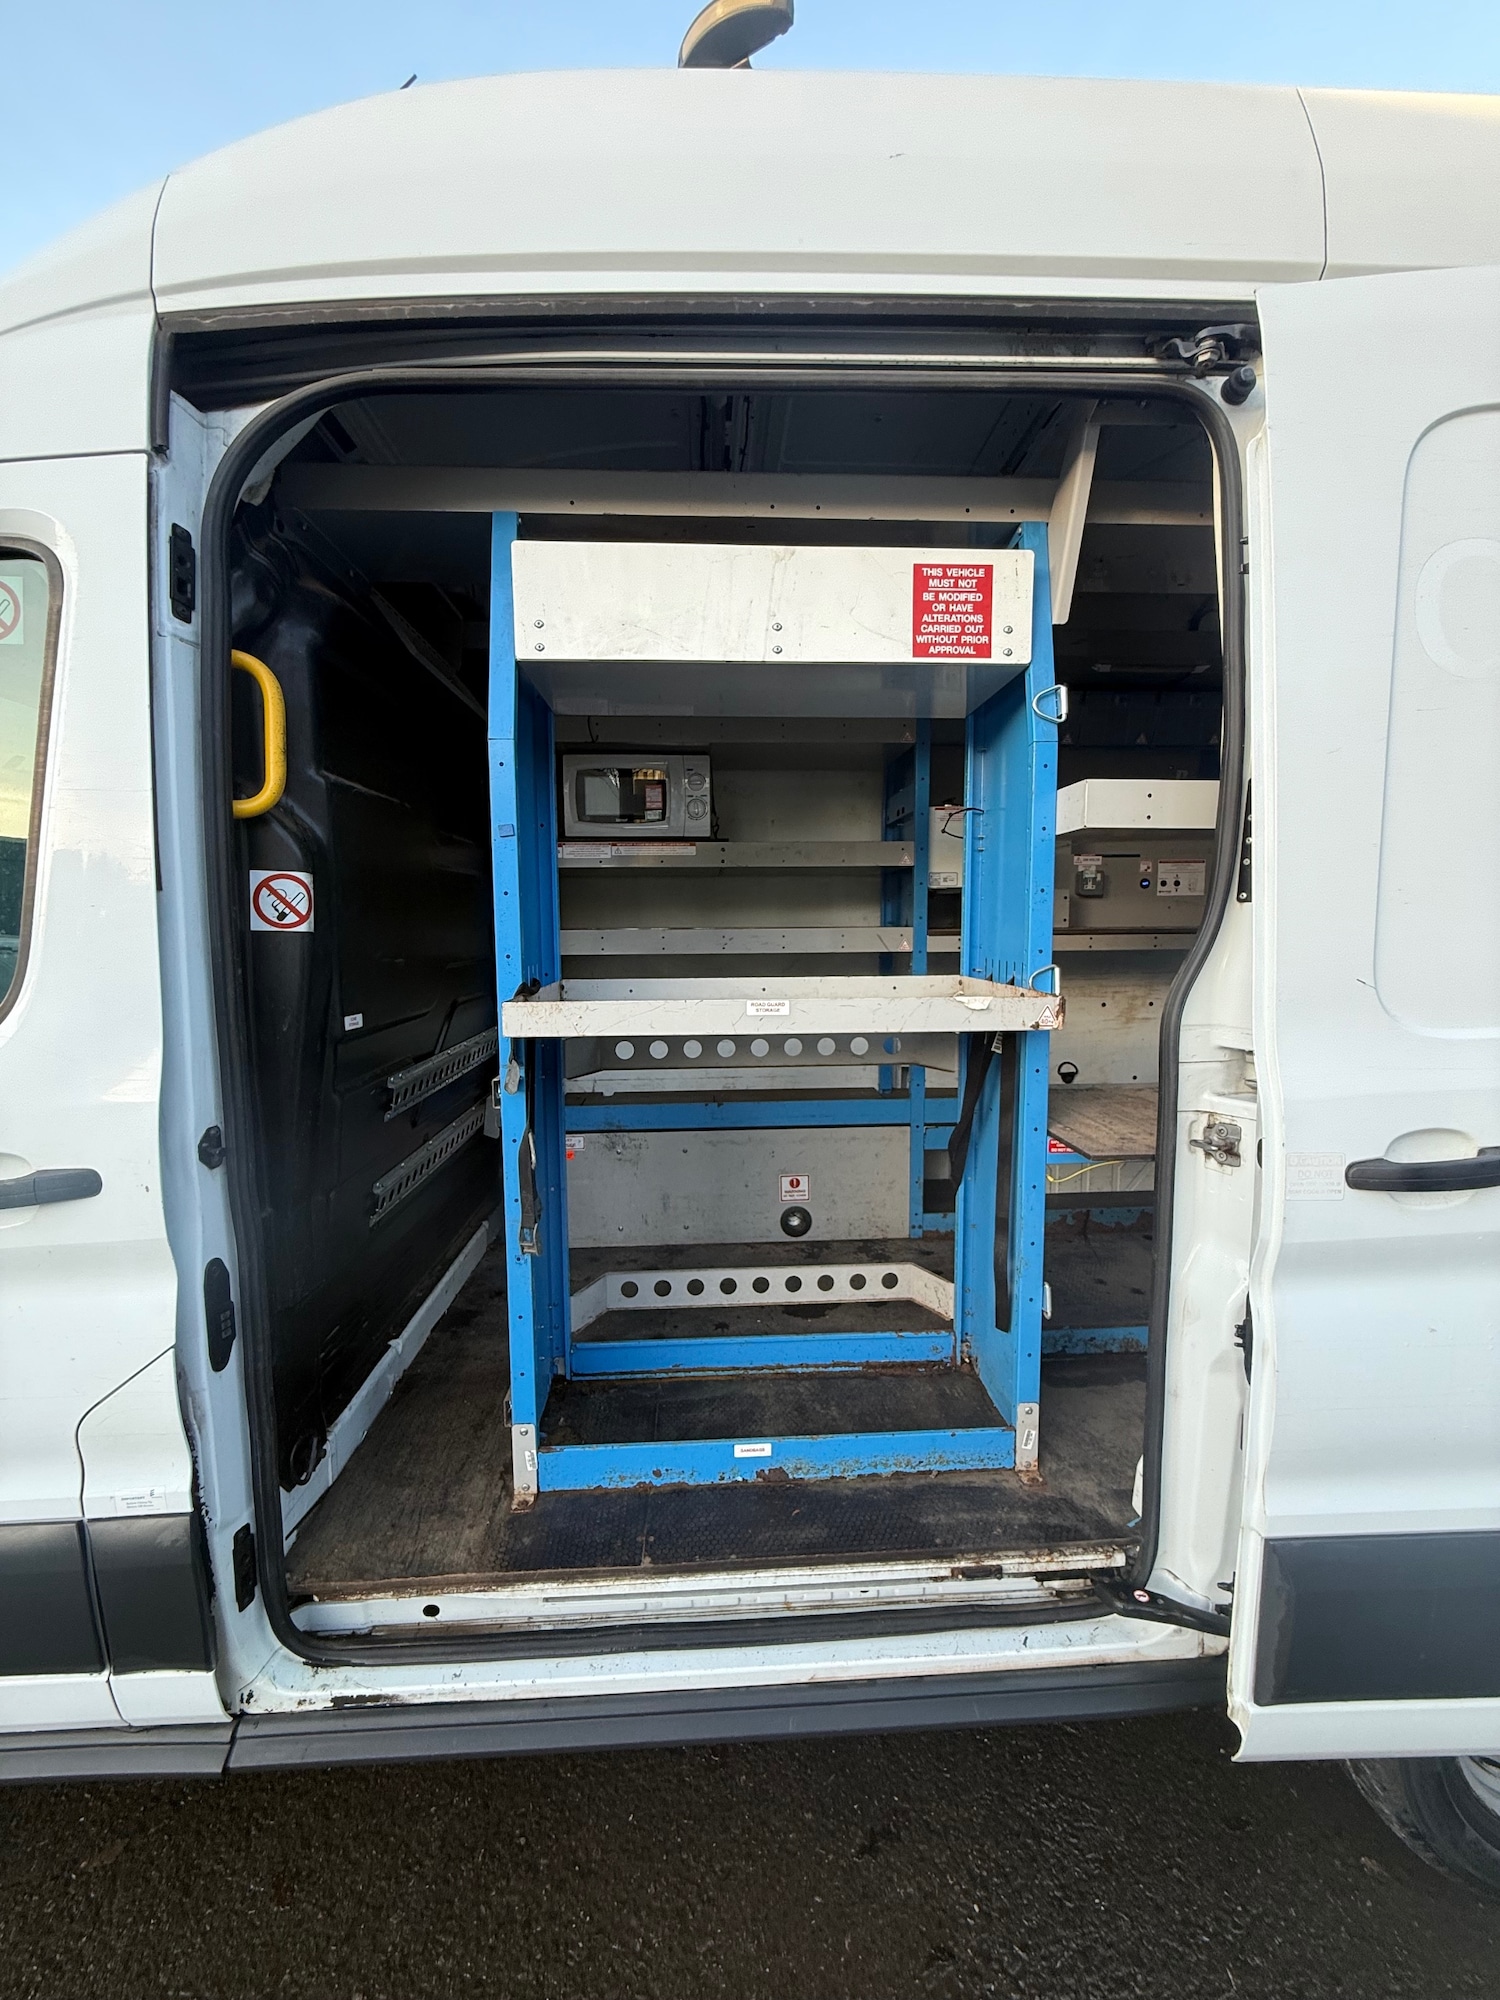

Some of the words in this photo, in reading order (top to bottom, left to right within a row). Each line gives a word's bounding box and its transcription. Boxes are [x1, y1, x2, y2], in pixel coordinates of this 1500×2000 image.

[922, 568, 943, 576] THIS
[946, 568, 985, 577] VEHICLE
[928, 579, 955, 587] MUST
[958, 579, 977, 588] NOT
[922, 592, 935, 601] BE
[938, 592, 983, 601] MODIFIED
[932, 603, 946, 612] OR
[949, 604, 974, 612] HAVE
[922, 614, 983, 623] ALTERATIONS
[920, 625, 961, 633] CARRIED
[964, 625, 984, 633] OUT
[916, 635, 957, 643] WITHOUT
[961, 635, 989, 644] PRIOR
[928, 646, 976, 654] APPROVAL
[1298, 1169, 1311, 1178] DO
[1314, 1169, 1333, 1178] NOT
